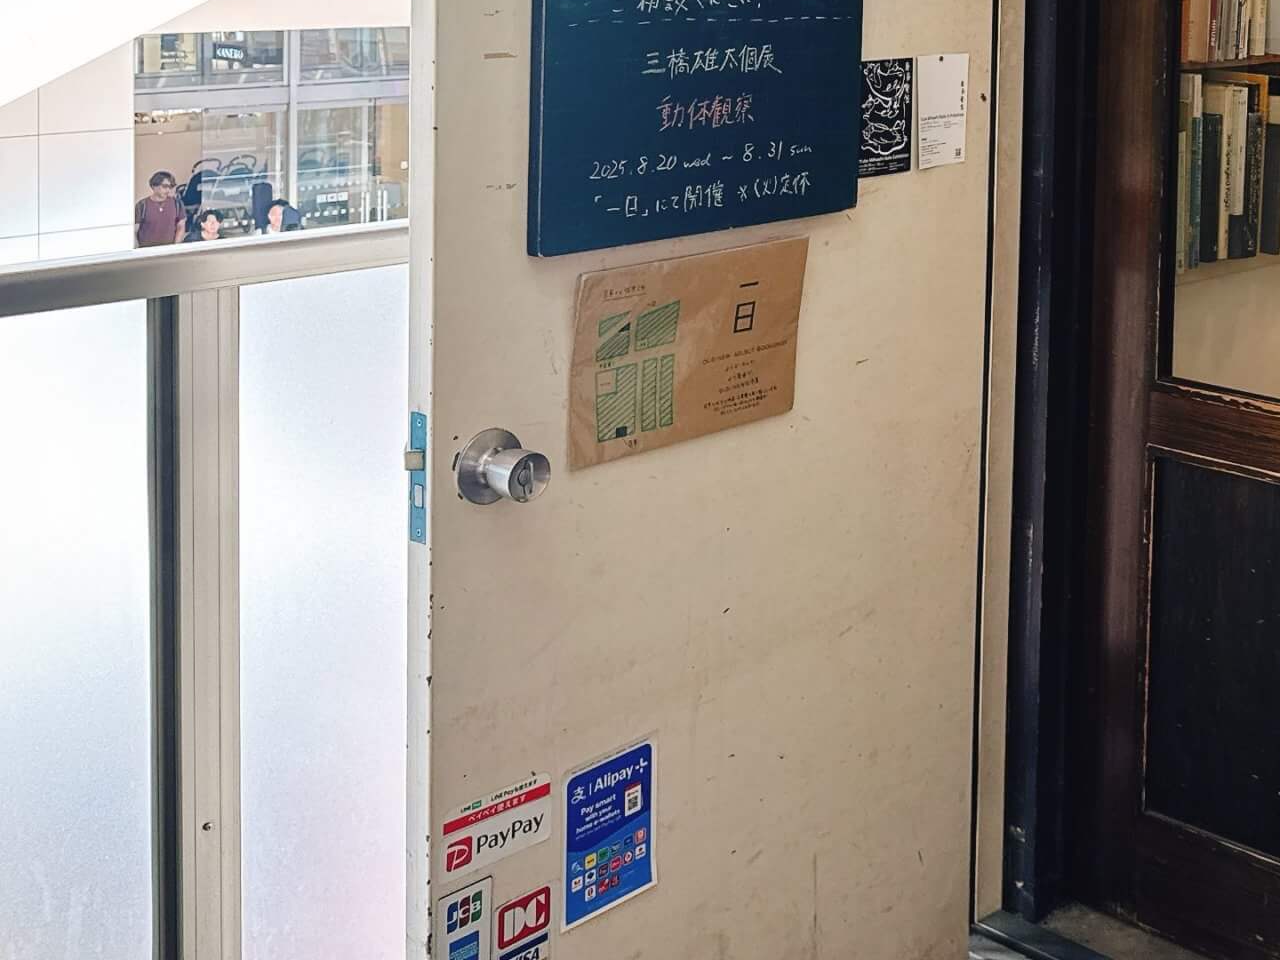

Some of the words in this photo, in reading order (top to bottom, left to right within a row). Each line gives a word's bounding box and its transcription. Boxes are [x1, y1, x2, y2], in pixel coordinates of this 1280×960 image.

[733, 281, 760, 333] 一日
[476, 812, 544, 854] PayPay
[447, 896, 482, 928] JCB
[503, 892, 546, 943] DC
